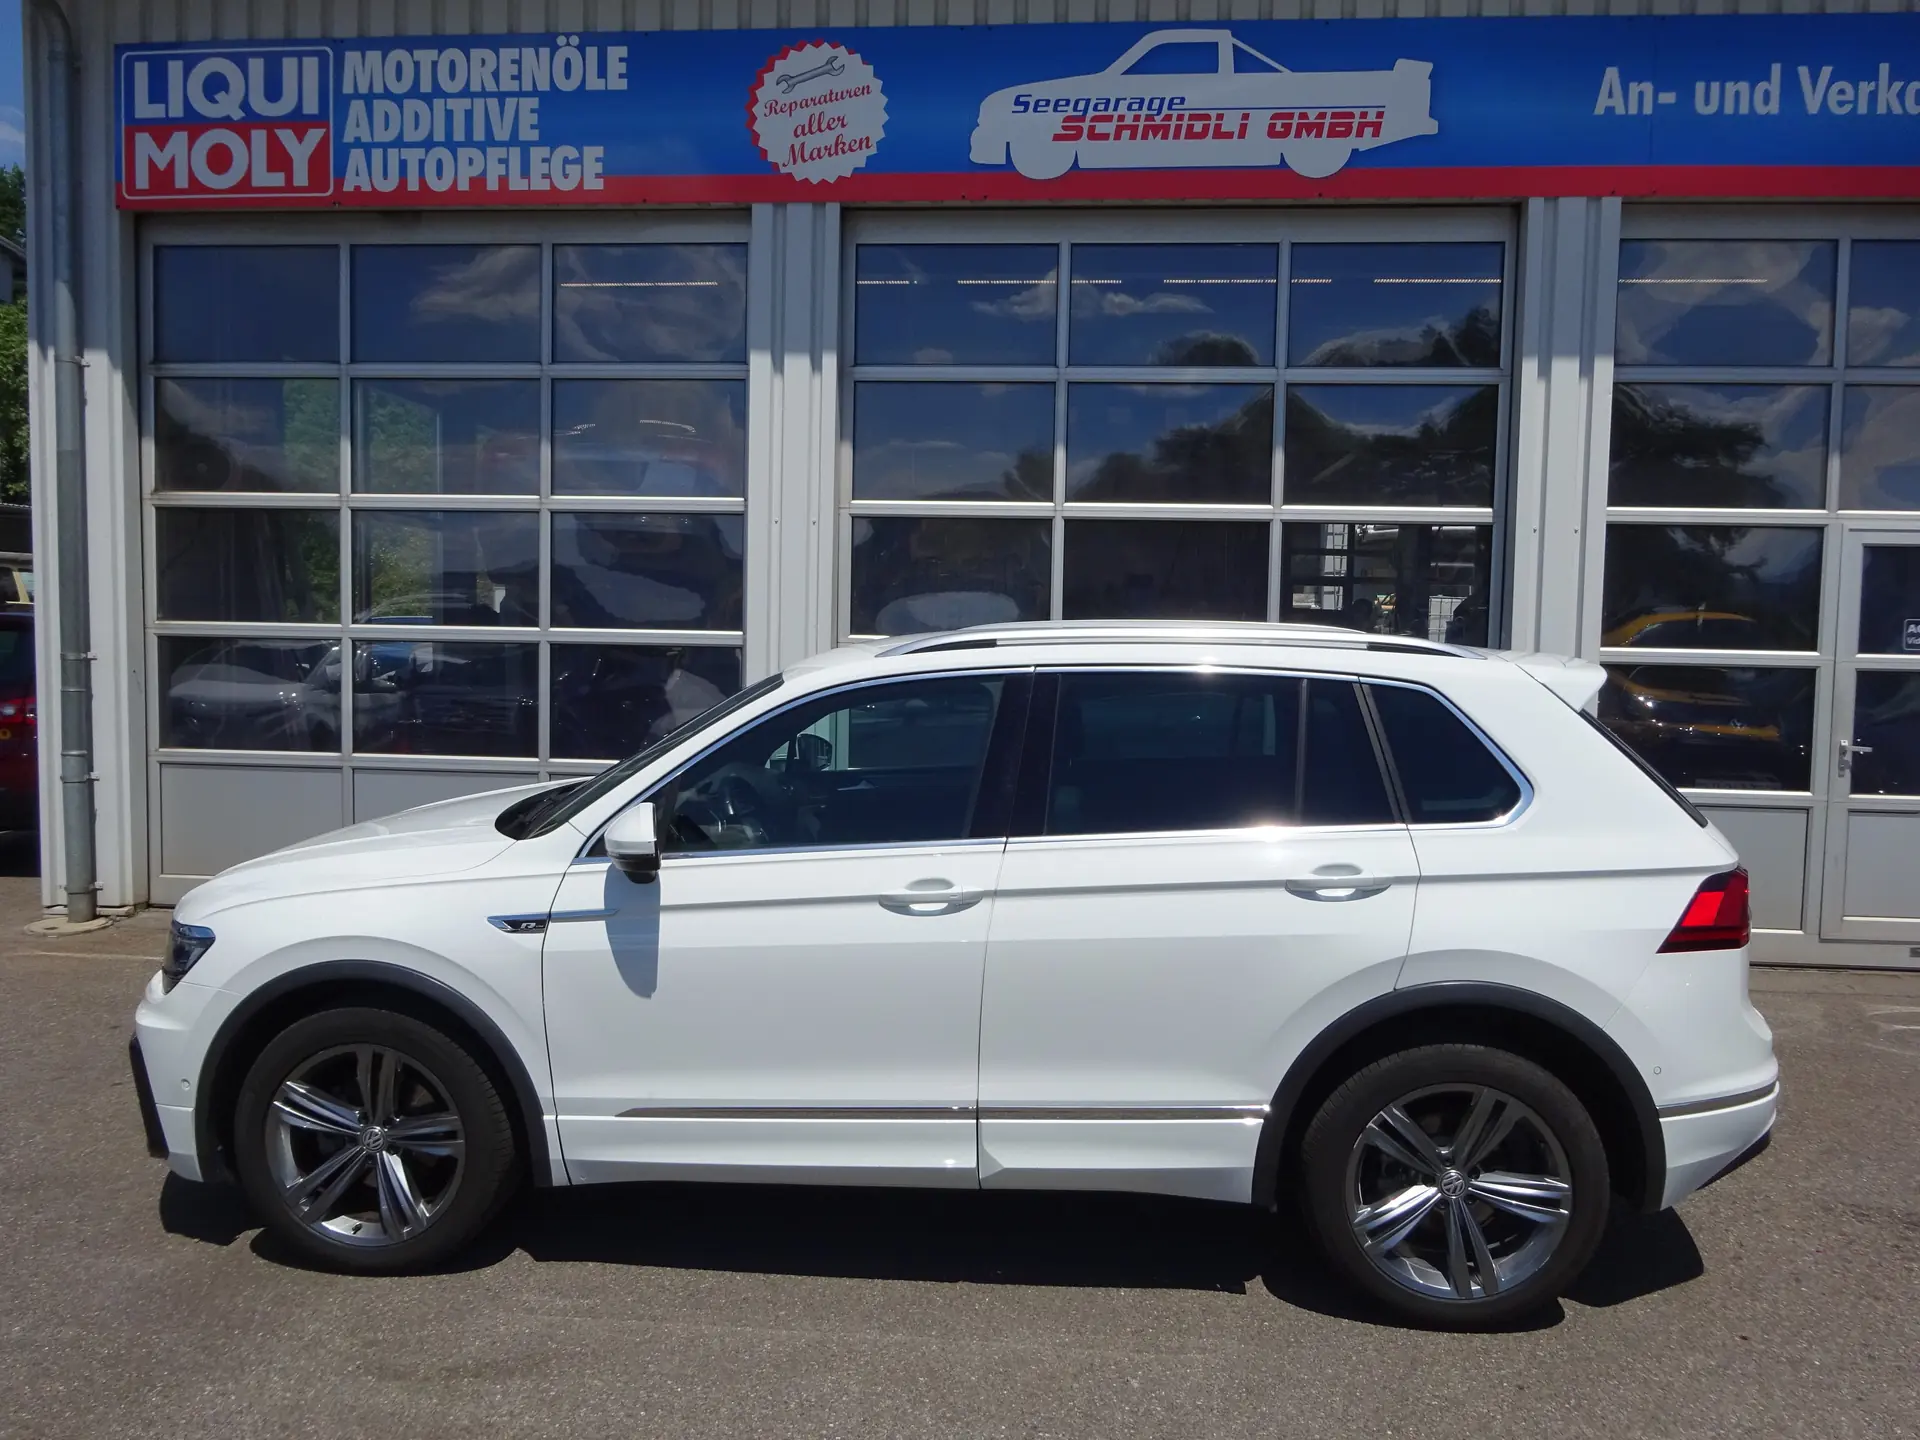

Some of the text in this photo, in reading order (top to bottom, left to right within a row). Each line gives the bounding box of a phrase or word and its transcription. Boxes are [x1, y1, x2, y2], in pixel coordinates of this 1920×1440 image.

[343, 35, 628, 94] MOTORENÖLE
[134, 56, 319, 121] LIQUI
[764, 84, 872, 117] Reparaturen
[1012, 94, 1186, 116] Seegarage
[1594, 66, 1676, 115] An-
[1694, 63, 1781, 115] und
[343, 97, 539, 143] ADDITIVE
[793, 111, 848, 138] aller
[1052, 111, 1385, 142] SCHMIDLI GMBH
[135, 128, 326, 189] MOLY
[343, 146, 604, 192] AUTOPFLEGE
[782, 133, 873, 167] Marken
